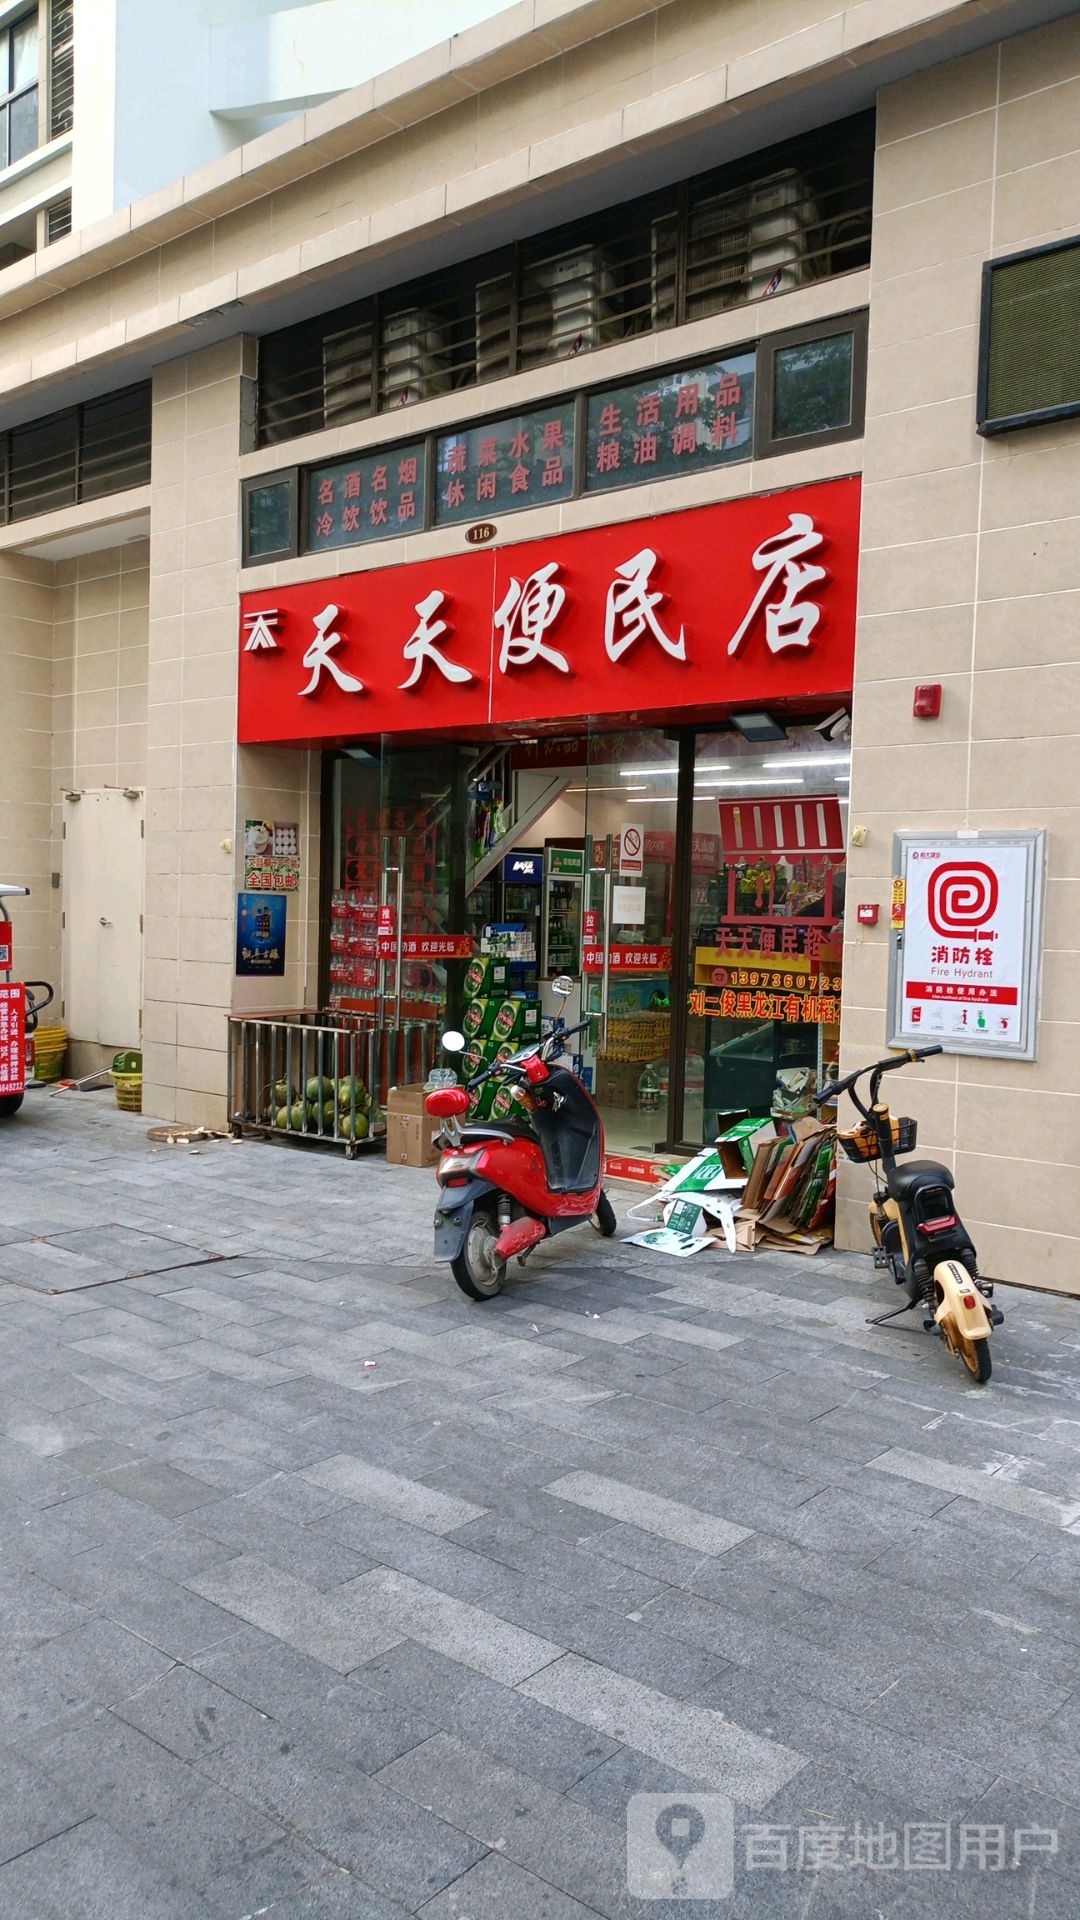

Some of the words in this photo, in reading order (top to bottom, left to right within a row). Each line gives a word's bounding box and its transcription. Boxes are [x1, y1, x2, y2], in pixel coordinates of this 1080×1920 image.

[598, 372, 742, 436] 生活用品
[444, 418, 564, 475] 蔬菜水果
[596, 410, 740, 474] 粮油调料
[317, 456, 418, 505] 名酒名烟
[443, 451, 565, 509] 休闲食品
[315, 492, 418, 538] 冷饮饮品
[471, 526, 491, 541] 116
[297, 513, 828, 698] 天天便民店
[247, 872, 298, 889] 全国包邮
[382, 908, 391, 919] 推
[586, 915, 594, 927] 拉
[421, 941, 455, 953] 欢迎光临
[931, 945, 994, 966] 消防栓
[625, 952, 657, 965] 欢迎光临
[730, 970, 841, 991] 1397360723
[930, 967, 950, 977] Fire
[954, 968, 993, 979] Hydrant
